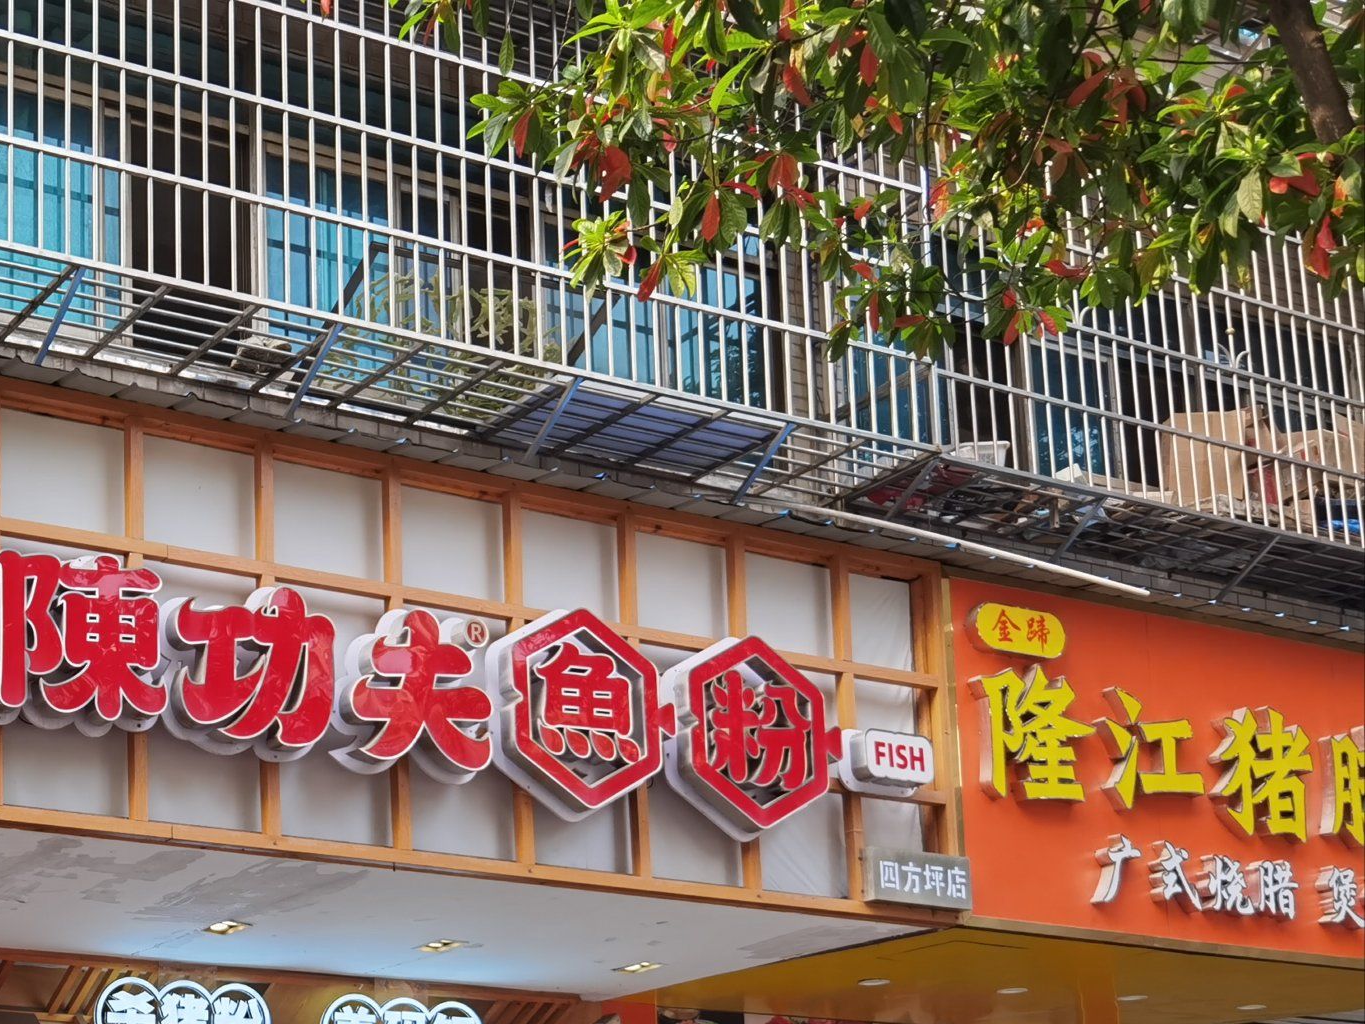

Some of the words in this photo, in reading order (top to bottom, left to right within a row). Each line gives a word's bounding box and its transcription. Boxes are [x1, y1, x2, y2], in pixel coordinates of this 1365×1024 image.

[991, 608, 1051, 653] 金蹄
[873, 739, 926, 773] FISH
[879, 858, 967, 899] 四方坪店
